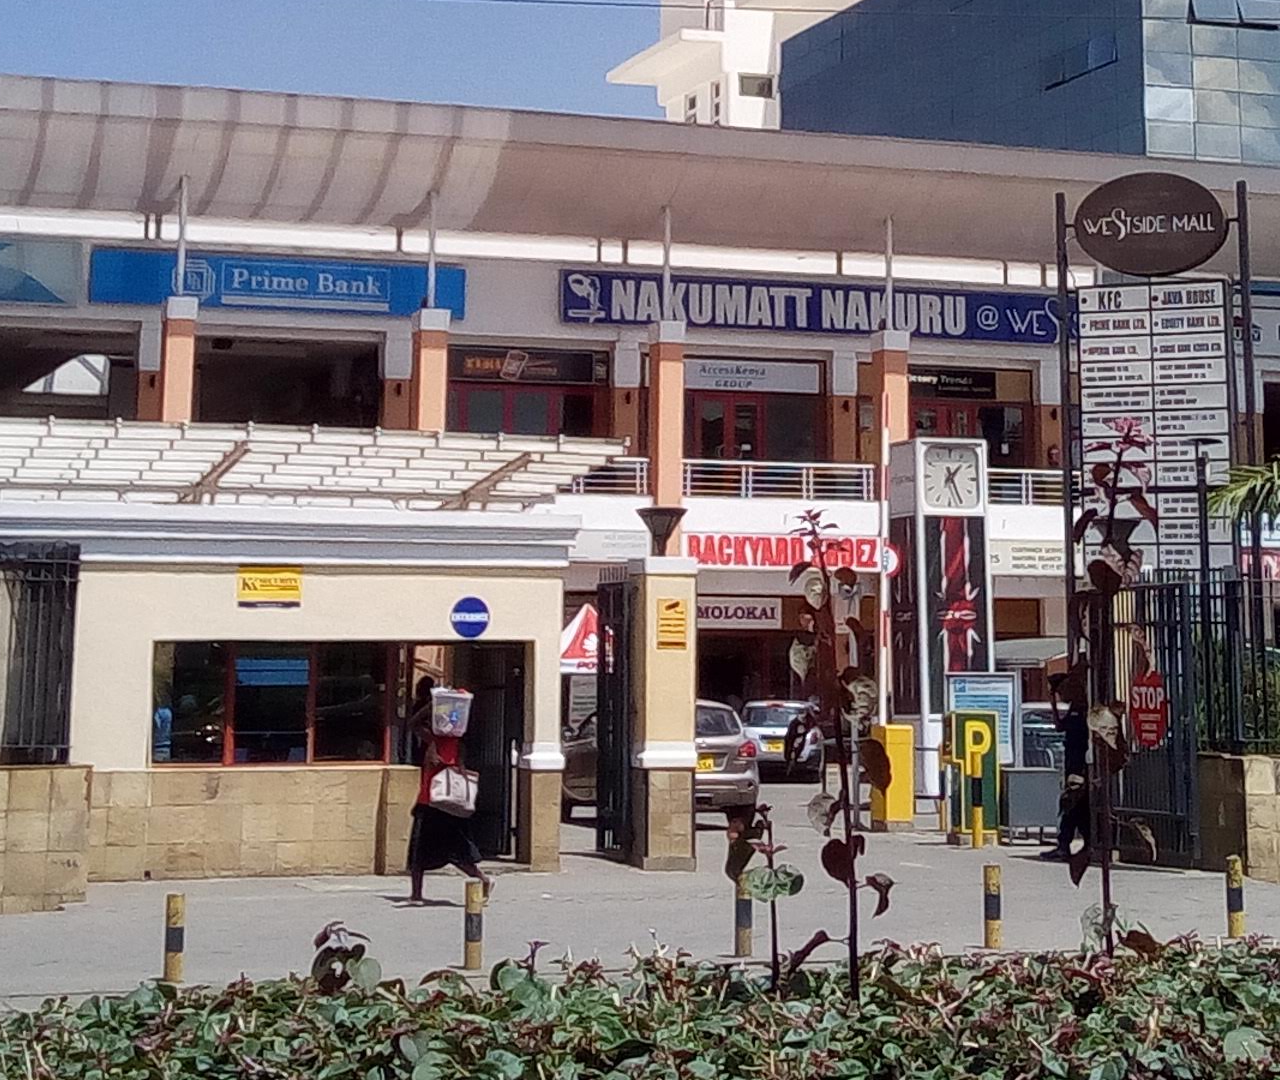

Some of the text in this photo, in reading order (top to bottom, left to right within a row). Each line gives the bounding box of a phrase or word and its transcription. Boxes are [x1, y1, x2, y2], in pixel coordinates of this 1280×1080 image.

[1083, 208, 1215, 241] WESTSIDE MALL
[231, 269, 382, 296] Prime Bank
[610, 279, 813, 328] NAKUMATT
[1098, 290, 1122, 311] KFC
[1161, 289, 1216, 305] JAVA HOUSE
[687, 534, 806, 567] BACKYARD
[696, 606, 778, 620] MOLOKAI
[1132, 686, 1164, 710] STOP
